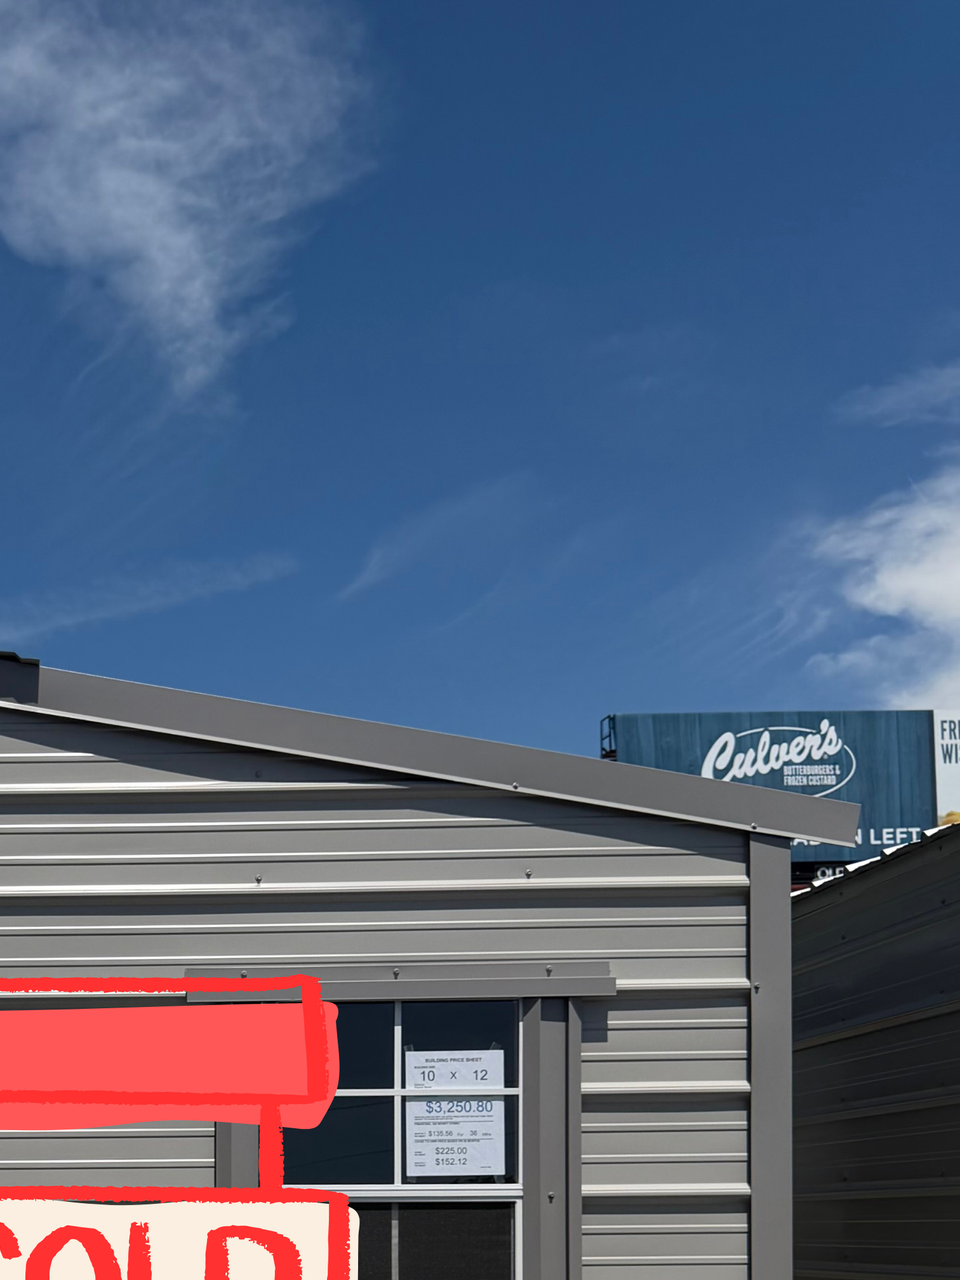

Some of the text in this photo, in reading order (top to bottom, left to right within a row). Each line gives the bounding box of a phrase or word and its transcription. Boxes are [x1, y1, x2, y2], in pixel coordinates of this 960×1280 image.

[941, 720, 960, 740] FR
[701, 719, 842, 782] Culver's
[941, 743, 960, 764] WI
[783, 765, 834, 775] BUTTERBURGERS
[783, 775, 837, 786] FROZEN CUSTARD
[869, 827, 920, 845] LEFT
[420, 1070, 436, 1081] 10
[473, 1069, 488, 1081] 12
[426, 1101, 493, 1114] $3,250.80
[435, 1147, 467, 1155] $225.00
[435, 1158, 467, 1166] $152.12
